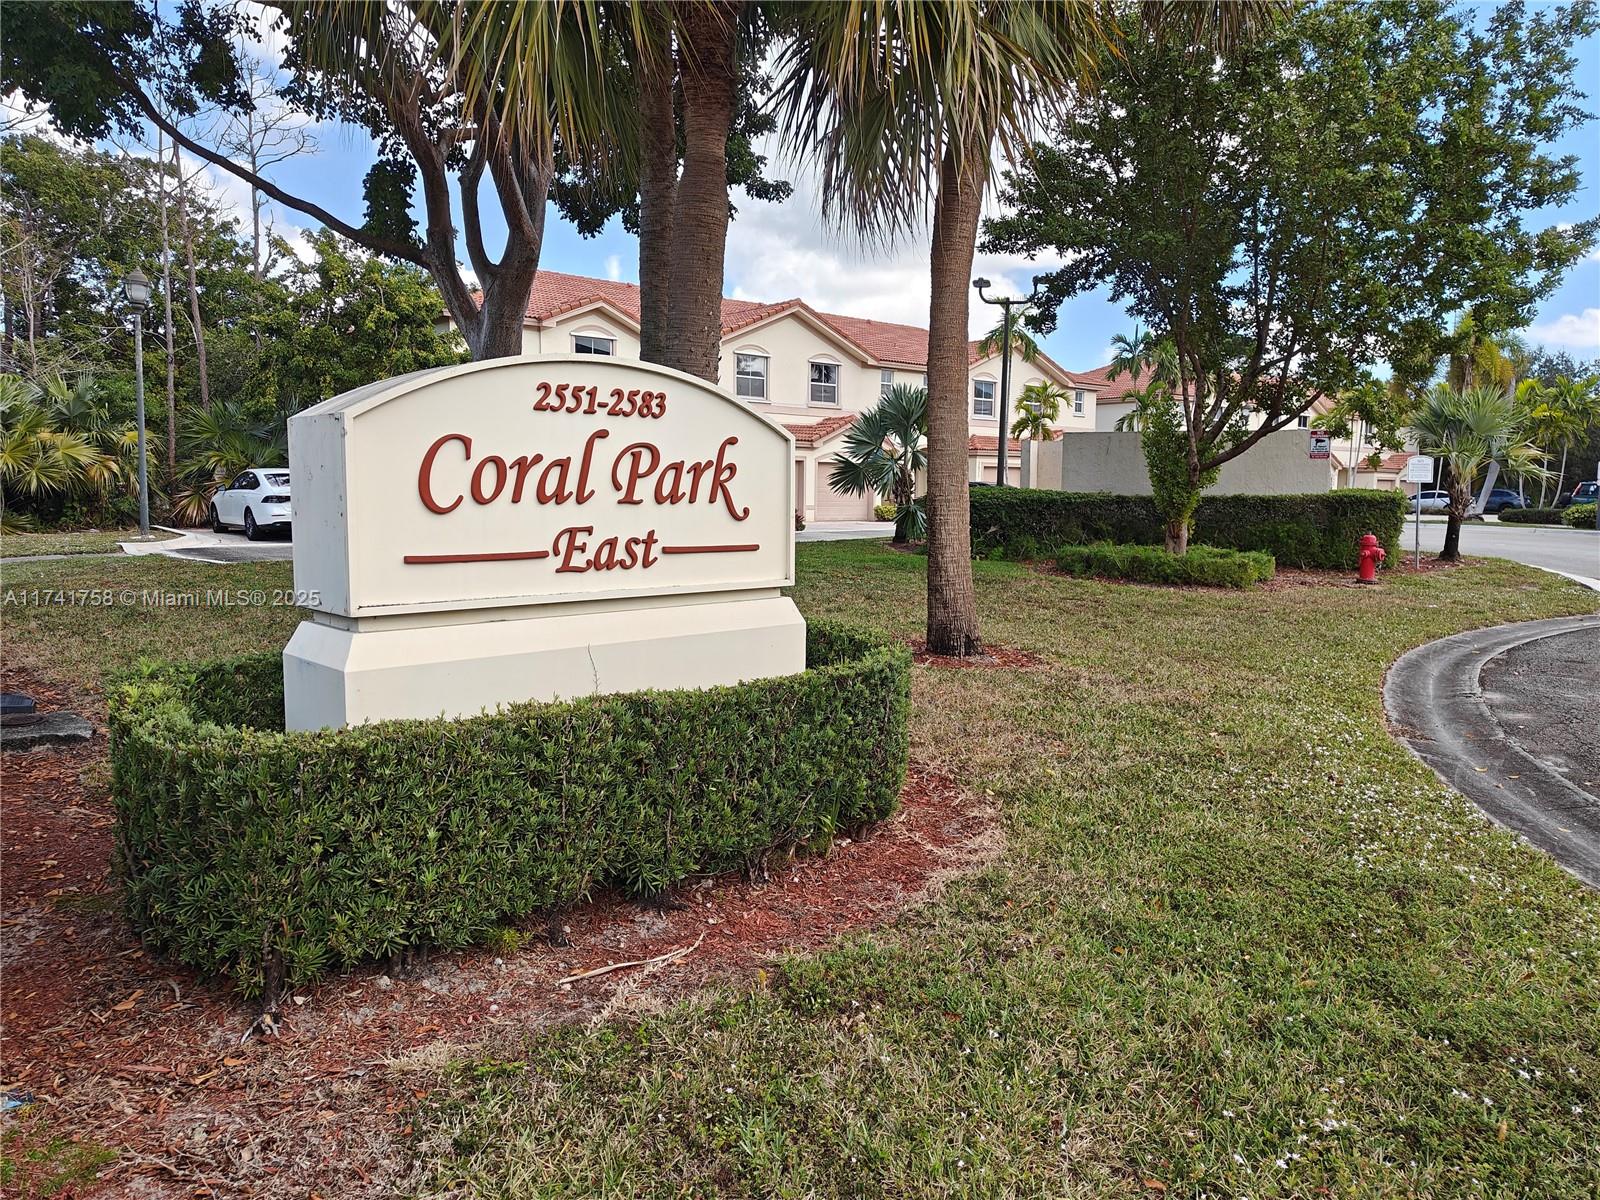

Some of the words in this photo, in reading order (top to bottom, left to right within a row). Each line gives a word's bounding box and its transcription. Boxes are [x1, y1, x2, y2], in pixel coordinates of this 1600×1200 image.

[534, 382, 667, 418] 2551-2583
[419, 429, 609, 514] Coral
[611, 436, 750, 522] Park
[554, 526, 661, 573] East
